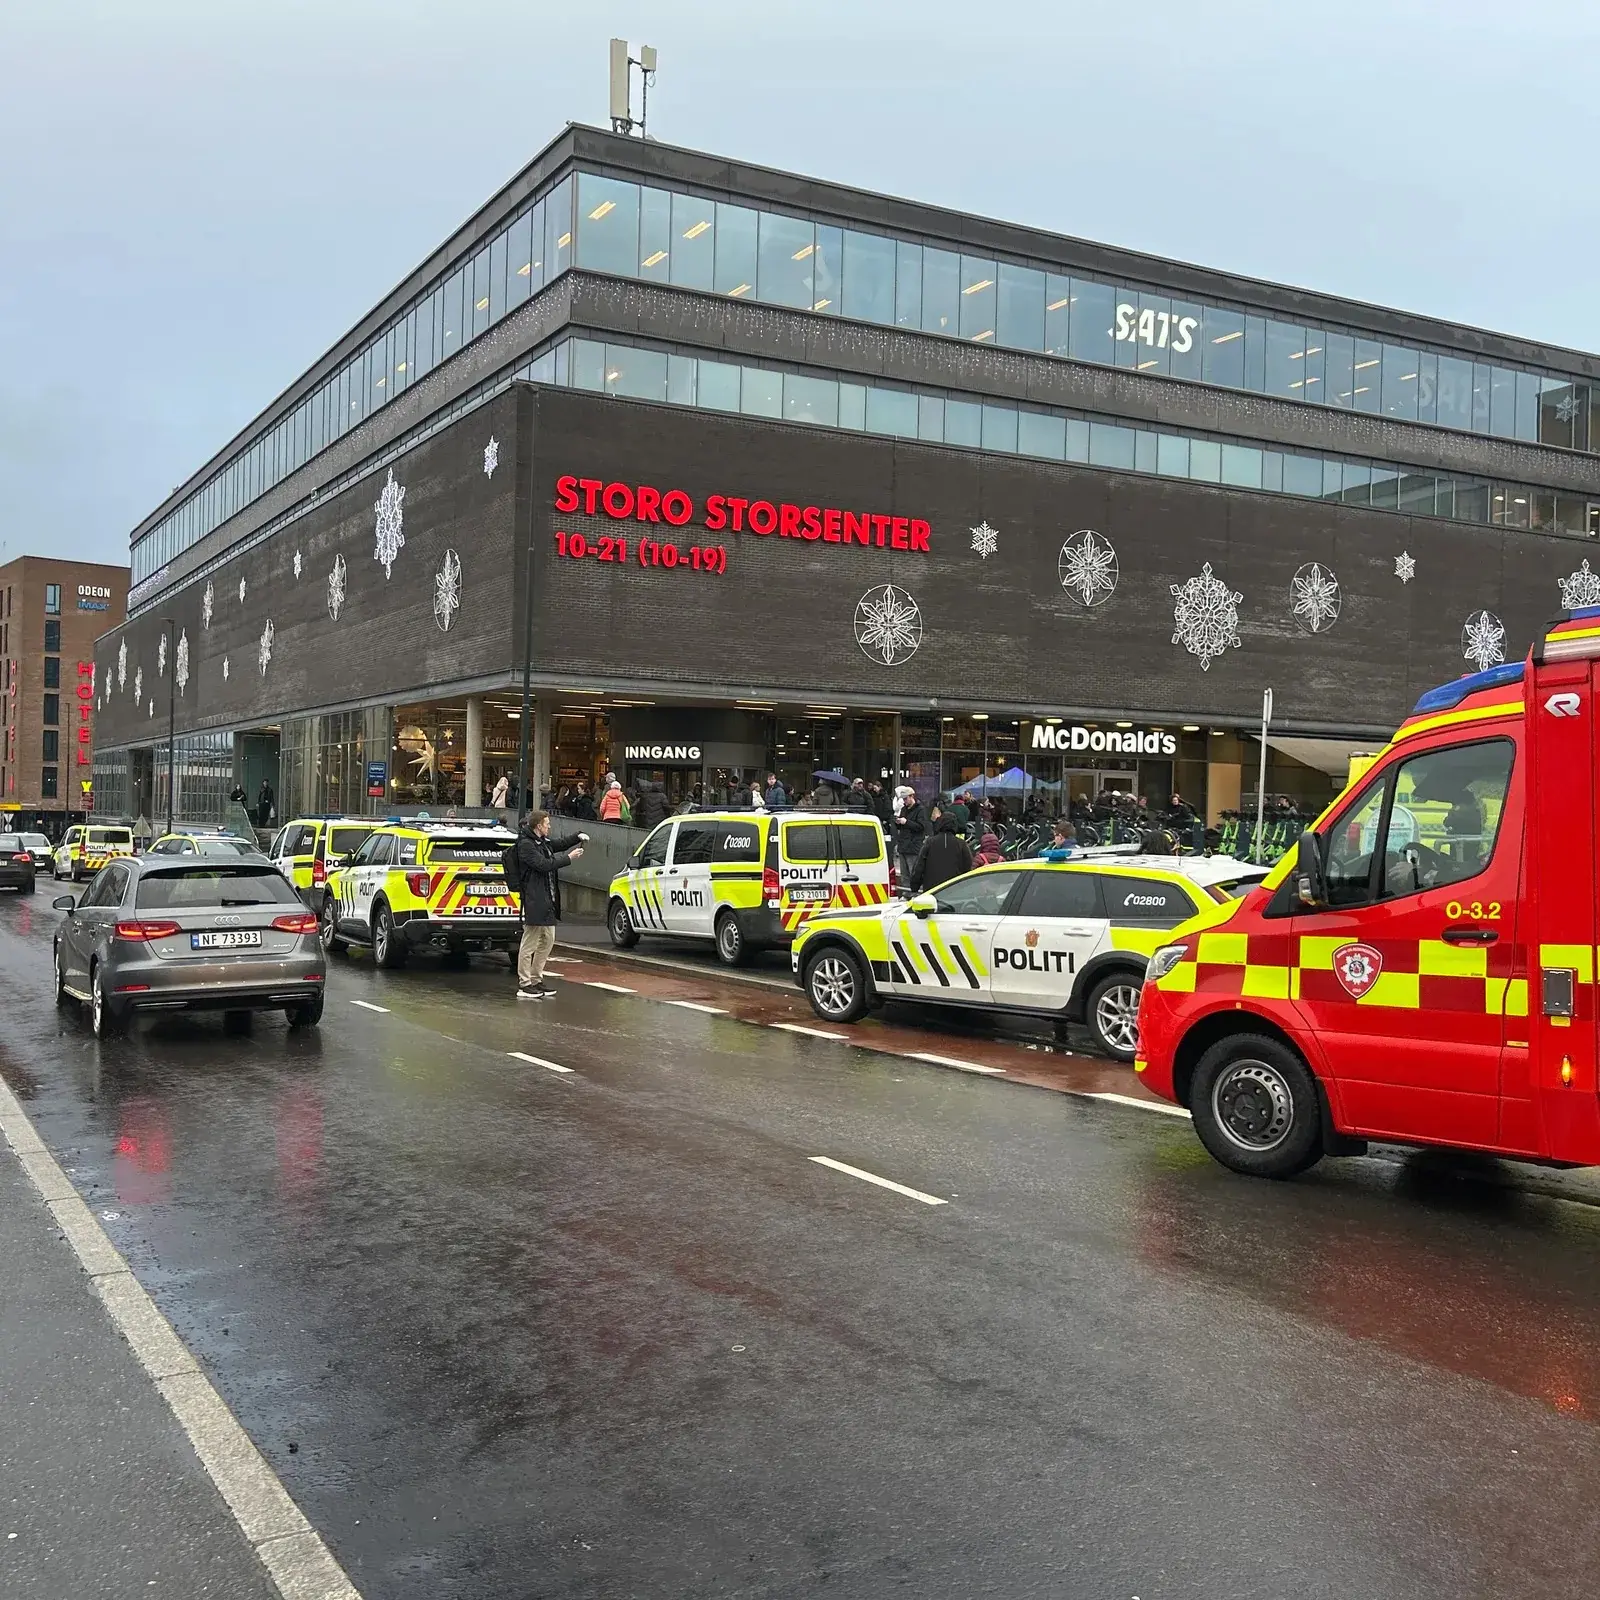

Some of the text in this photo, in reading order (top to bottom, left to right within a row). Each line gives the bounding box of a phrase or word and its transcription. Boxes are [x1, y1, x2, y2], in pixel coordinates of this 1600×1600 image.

[1107, 303, 1198, 353] SATS
[555, 475, 931, 552] STORO STORSENTER
[555, 532, 727, 575] 10-21 (10-19)
[78, 585, 111, 598] ODEON
[77, 661, 94, 766] HOTEL
[1031, 724, 1177, 755] McDonald's
[625, 745, 701, 760] INNGANG
[730, 837, 751, 848] 02800
[453, 850, 503, 858] Innsatsled
[781, 868, 823, 880] POLITI
[360, 882, 376, 897] POLITI
[671, 890, 703, 907] POLITI
[1133, 896, 1166, 906] 02800
[463, 906, 512, 915] POLITI
[1446, 901, 1501, 919] O-3.2
[202, 932, 258, 945] NF 73393
[993, 947, 1075, 974] POLITI
